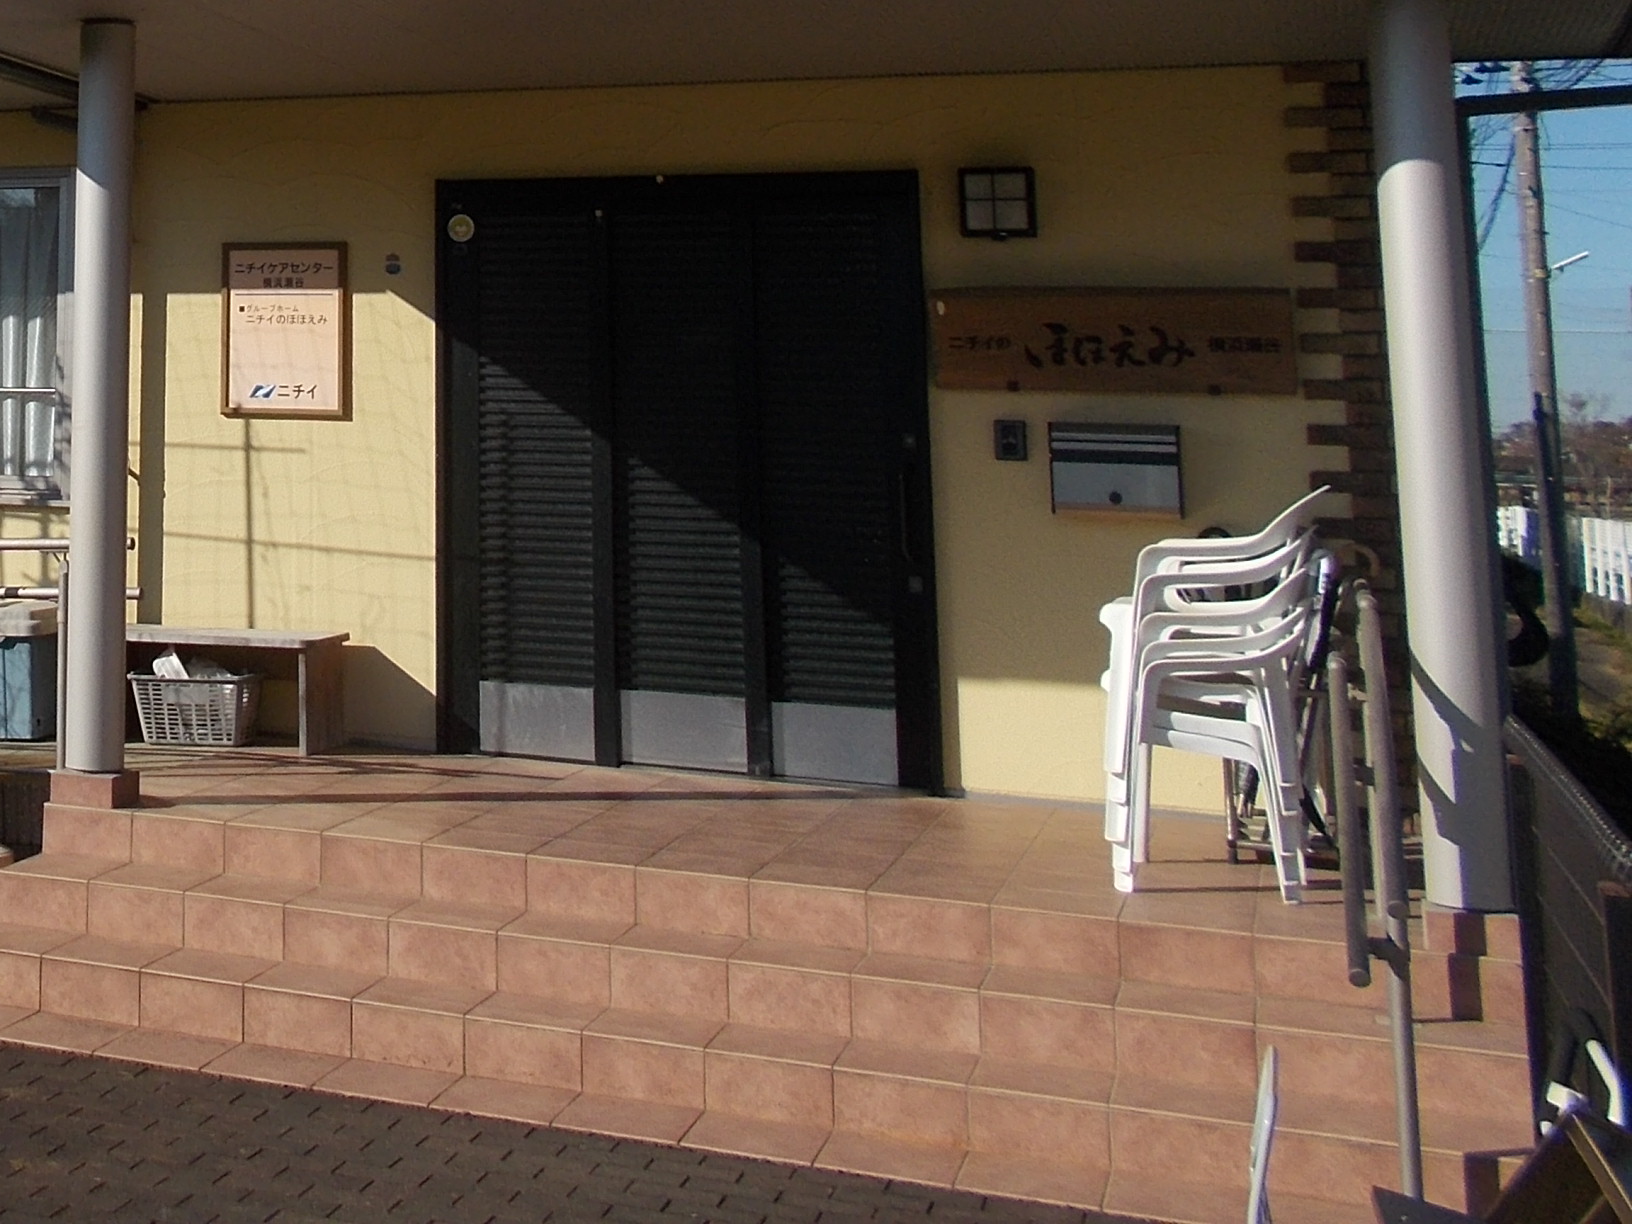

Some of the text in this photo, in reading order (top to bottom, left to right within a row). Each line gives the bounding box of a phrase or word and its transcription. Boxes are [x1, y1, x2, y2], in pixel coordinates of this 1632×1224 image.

[234, 262, 334, 274] ニチイケアセンター
[246, 304, 299, 313] グループホーム
[245, 314, 328, 325] ニチイのほほえみ
[948, 335, 1011, 352] ニチイの
[277, 384, 318, 400] ニチイ
